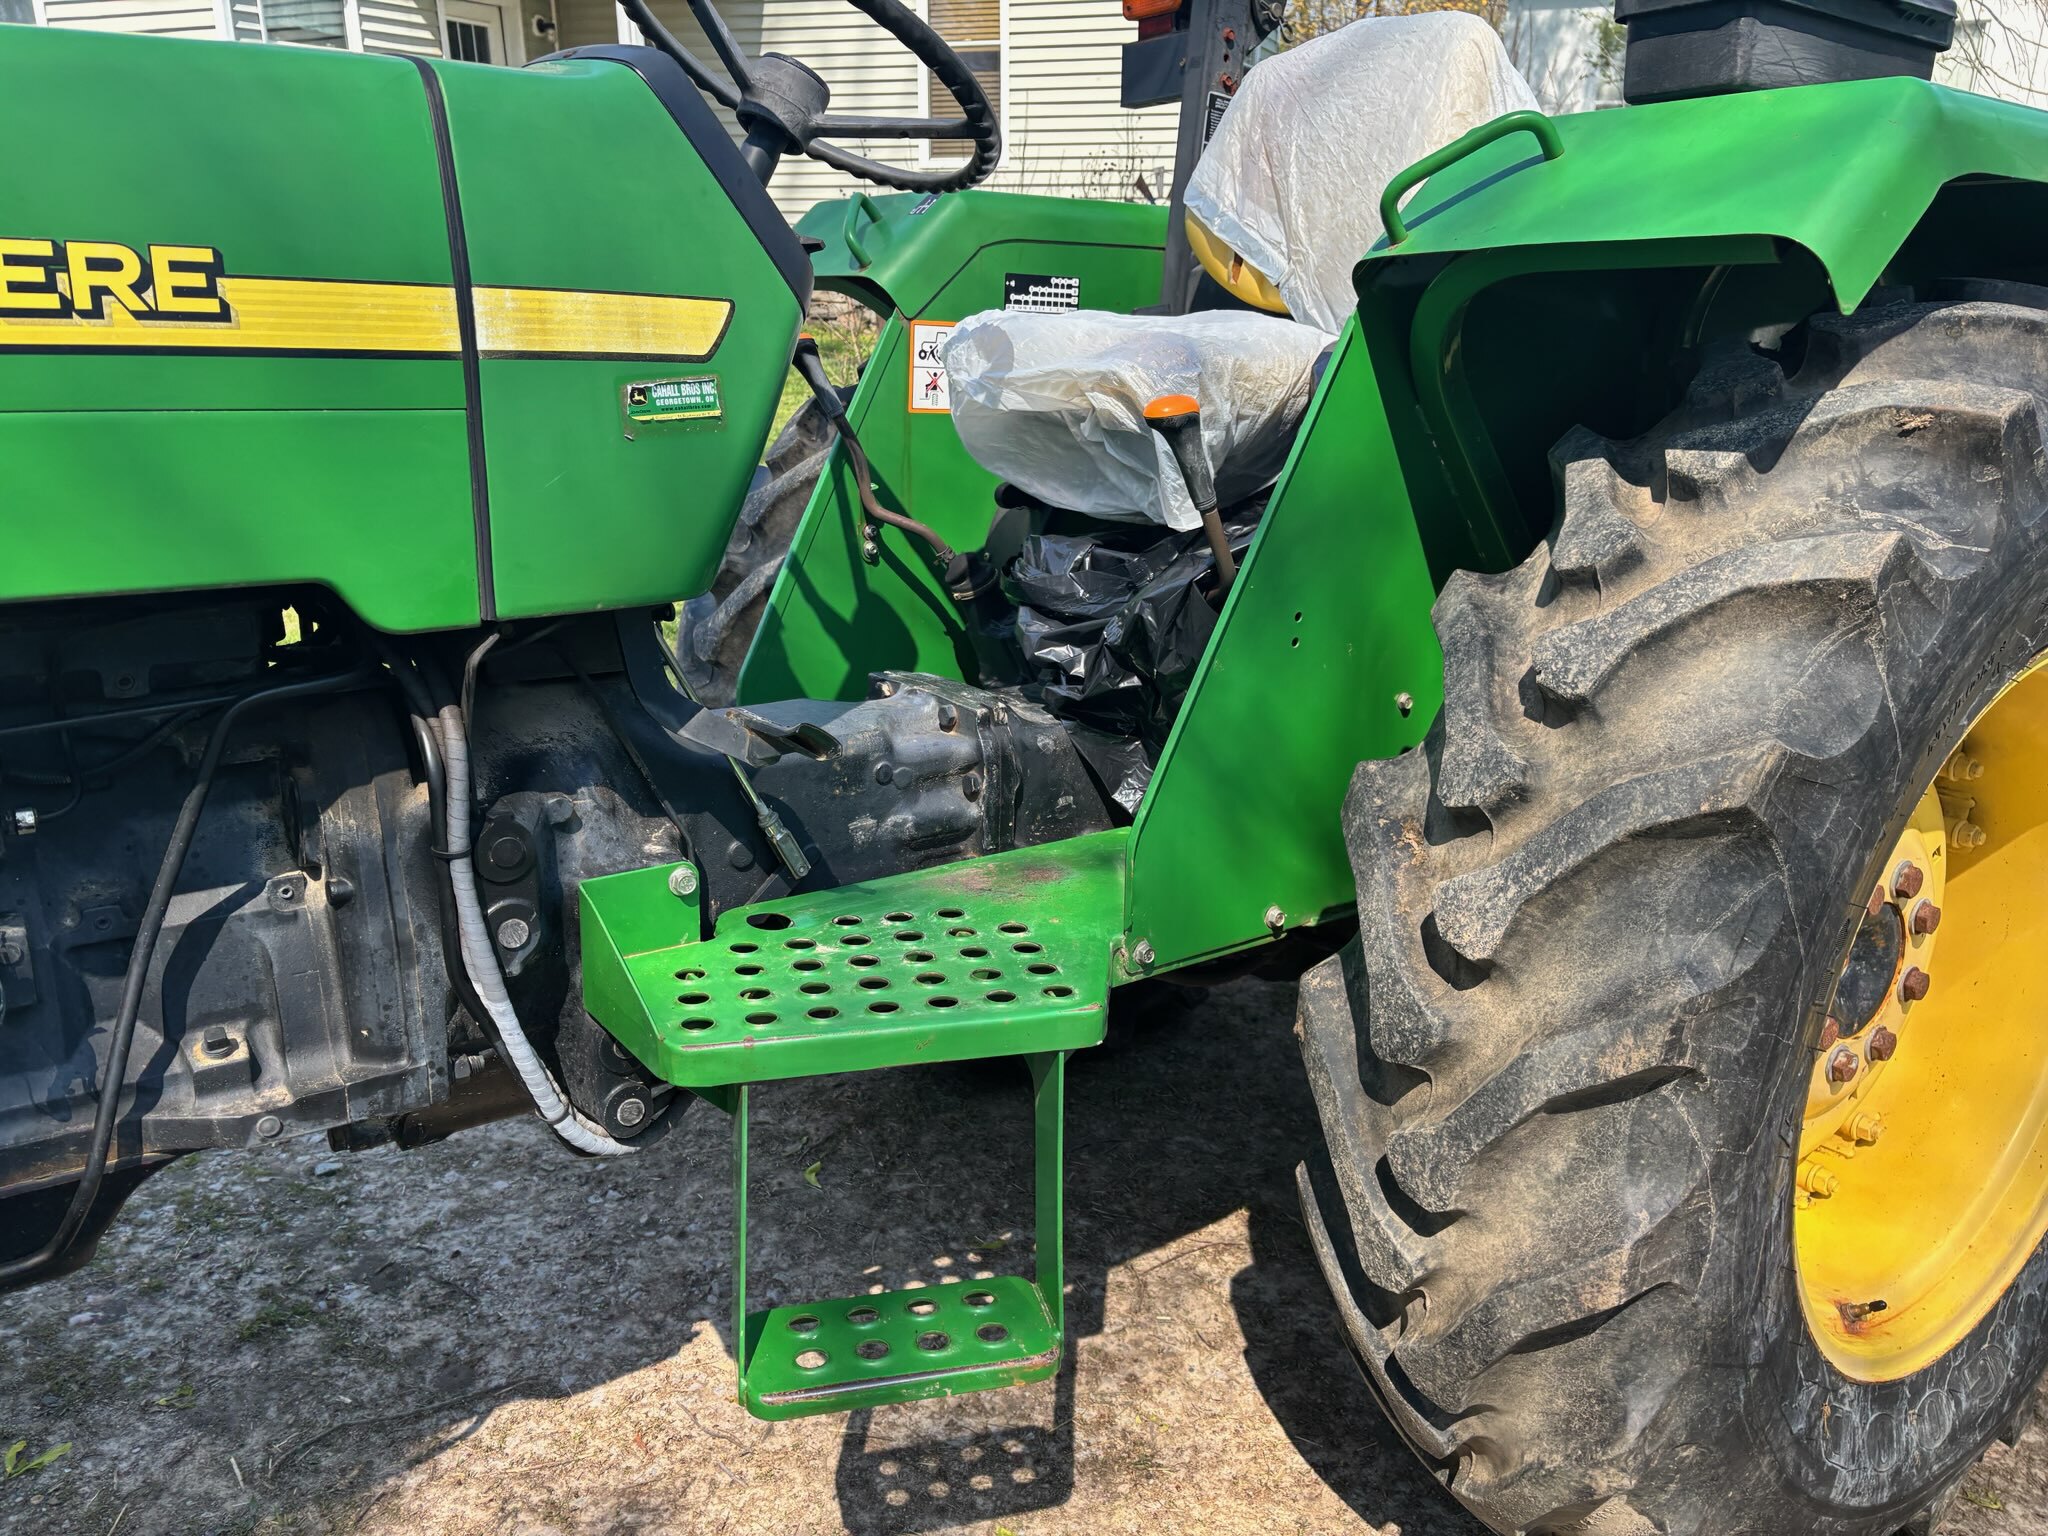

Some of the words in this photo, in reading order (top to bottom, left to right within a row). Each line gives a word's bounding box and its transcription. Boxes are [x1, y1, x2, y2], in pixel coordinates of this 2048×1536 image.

[652, 384, 680, 398] CAHALL
[681, 382, 700, 396] BROS
[656, 396, 704, 406] GEORGETOWN,
[705, 395, 714, 403] OH
